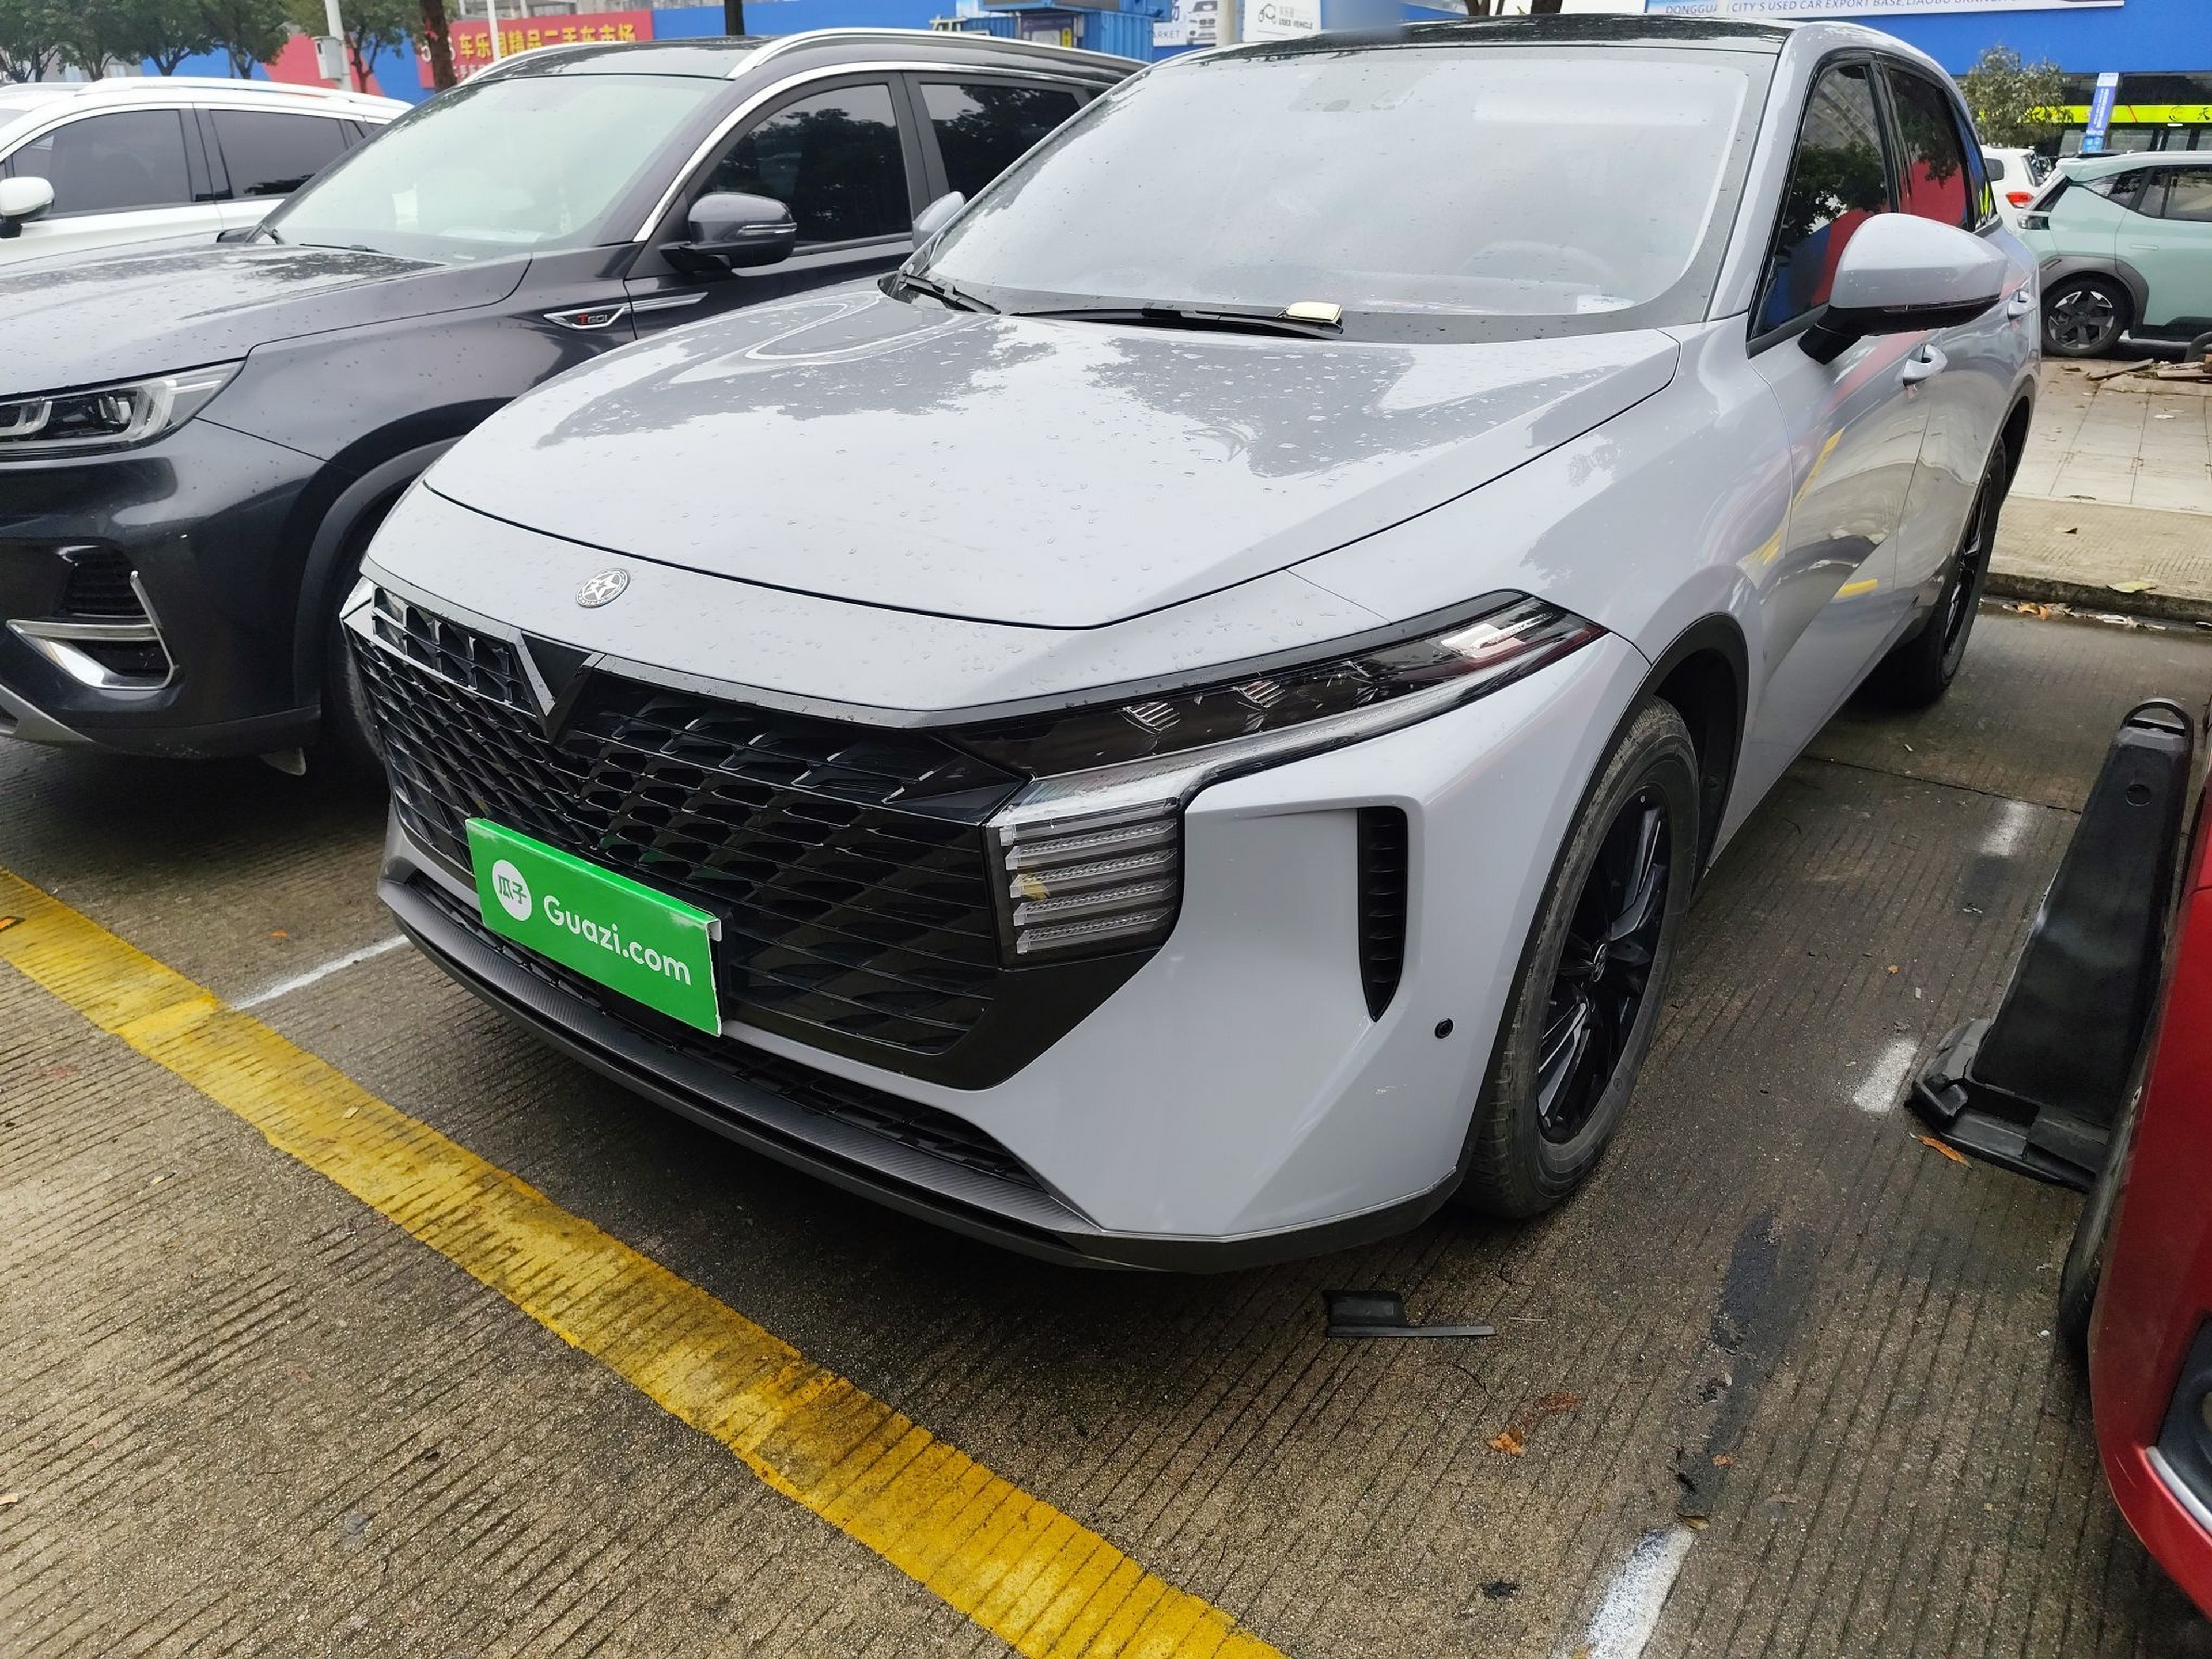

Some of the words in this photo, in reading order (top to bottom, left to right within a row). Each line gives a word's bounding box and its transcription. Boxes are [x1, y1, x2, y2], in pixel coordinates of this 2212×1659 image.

[1768, 1, 1797, 10] USED
[1800, 0, 1823, 9] CAR
[498, 875, 527, 904] 瓜子
[543, 895, 691, 986] Guazi.com
